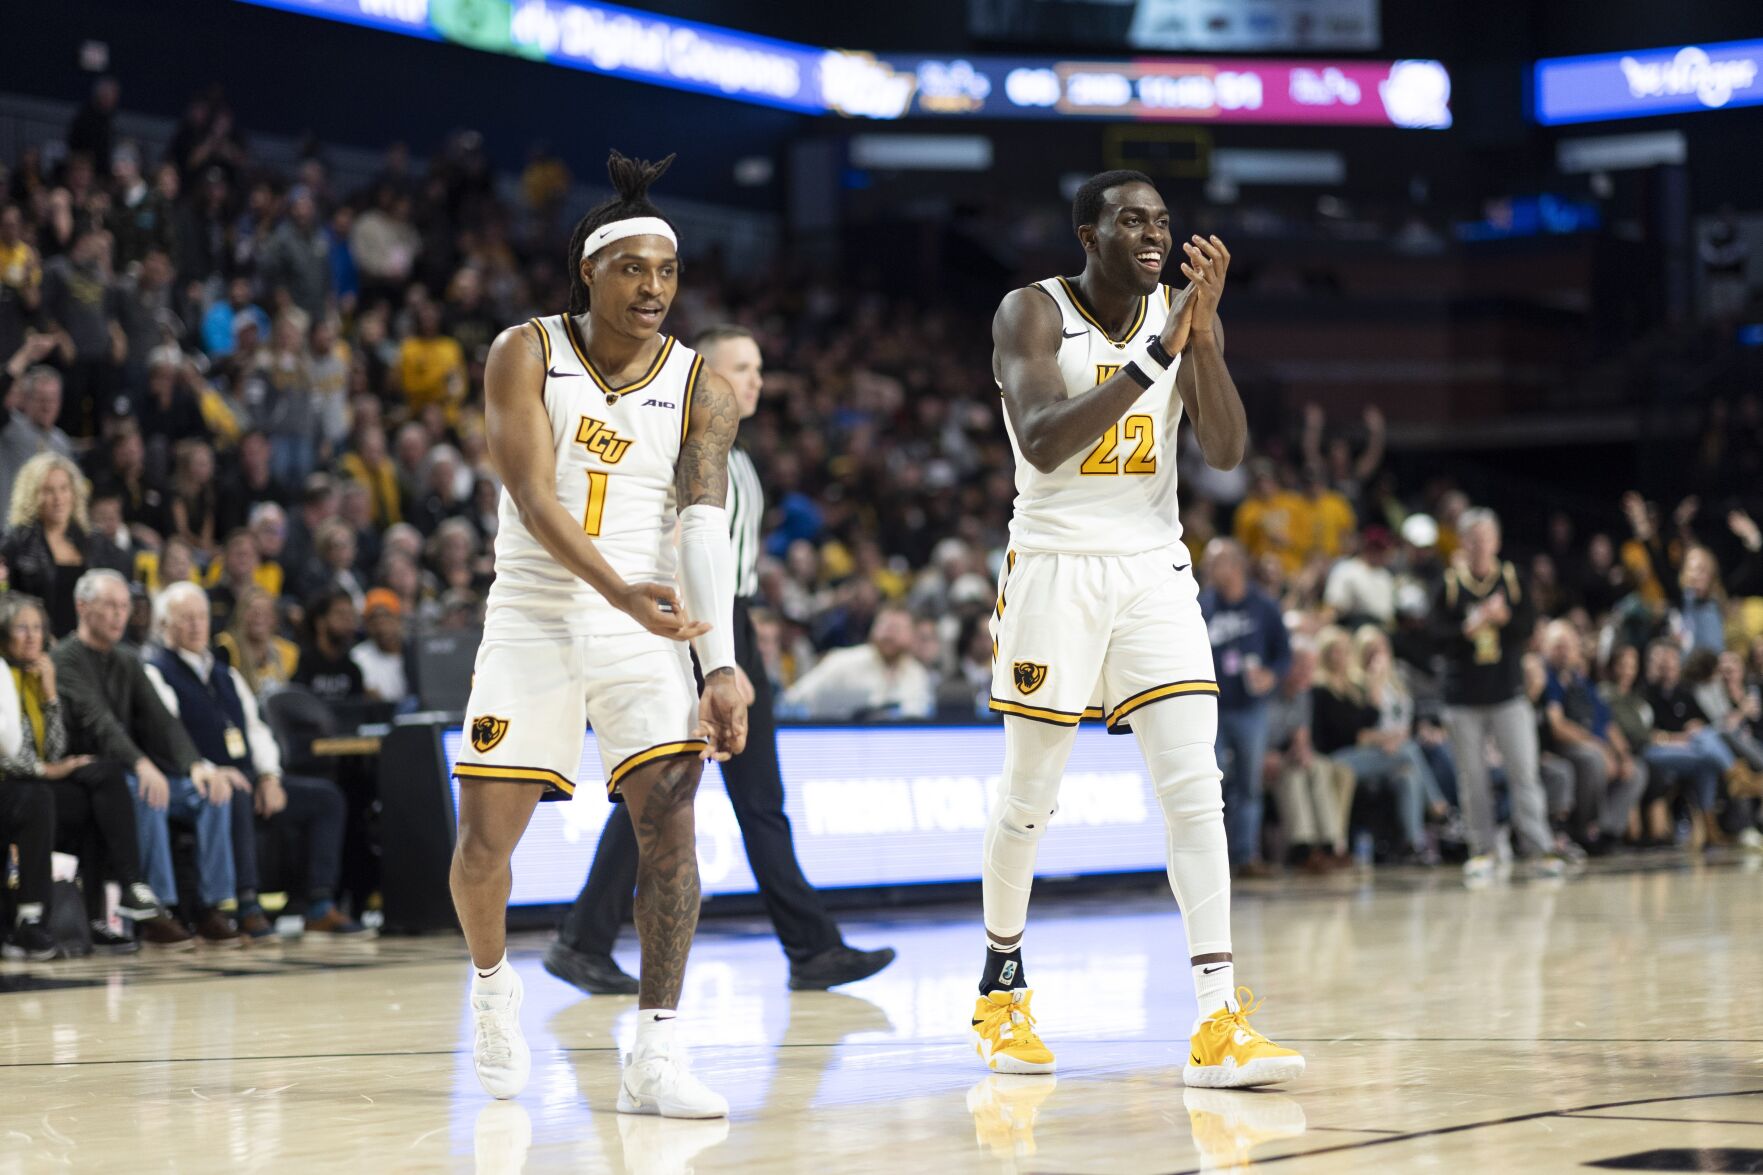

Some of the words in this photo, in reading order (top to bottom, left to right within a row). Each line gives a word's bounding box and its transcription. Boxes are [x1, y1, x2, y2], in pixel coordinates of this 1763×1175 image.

[576, 415, 633, 464] VCU
[1080, 414, 1157, 475] 22
[583, 471, 608, 537] 1
